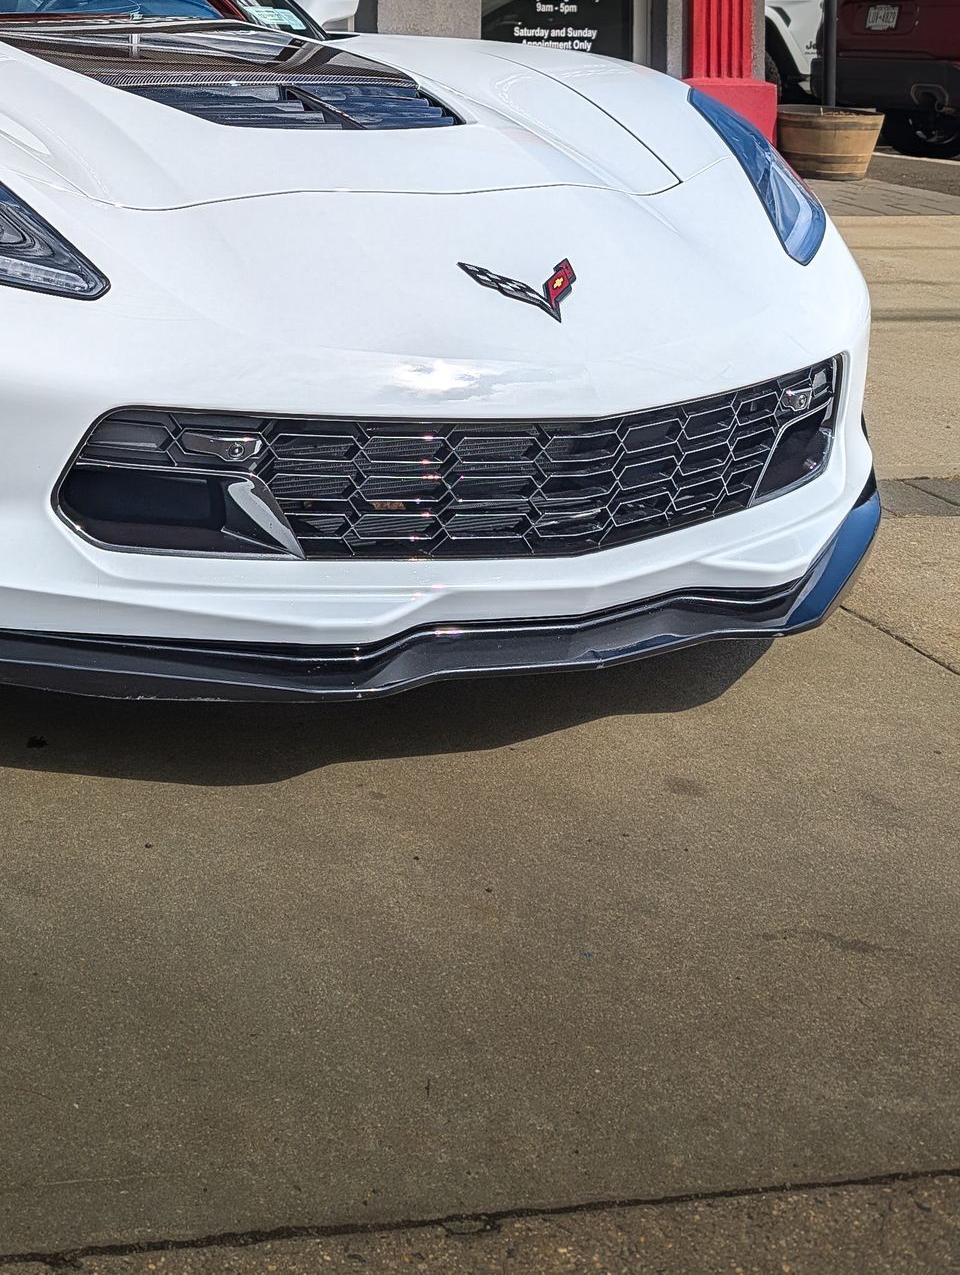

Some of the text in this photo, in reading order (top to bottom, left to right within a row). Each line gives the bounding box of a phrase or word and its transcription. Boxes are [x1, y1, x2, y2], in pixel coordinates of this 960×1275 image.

[536, 2, 553, 12] 9am
[559, 3, 577, 14] 5pm
[513, 26, 597, 40] Saturday and Sunday
[573, 40, 592, 52] Only
